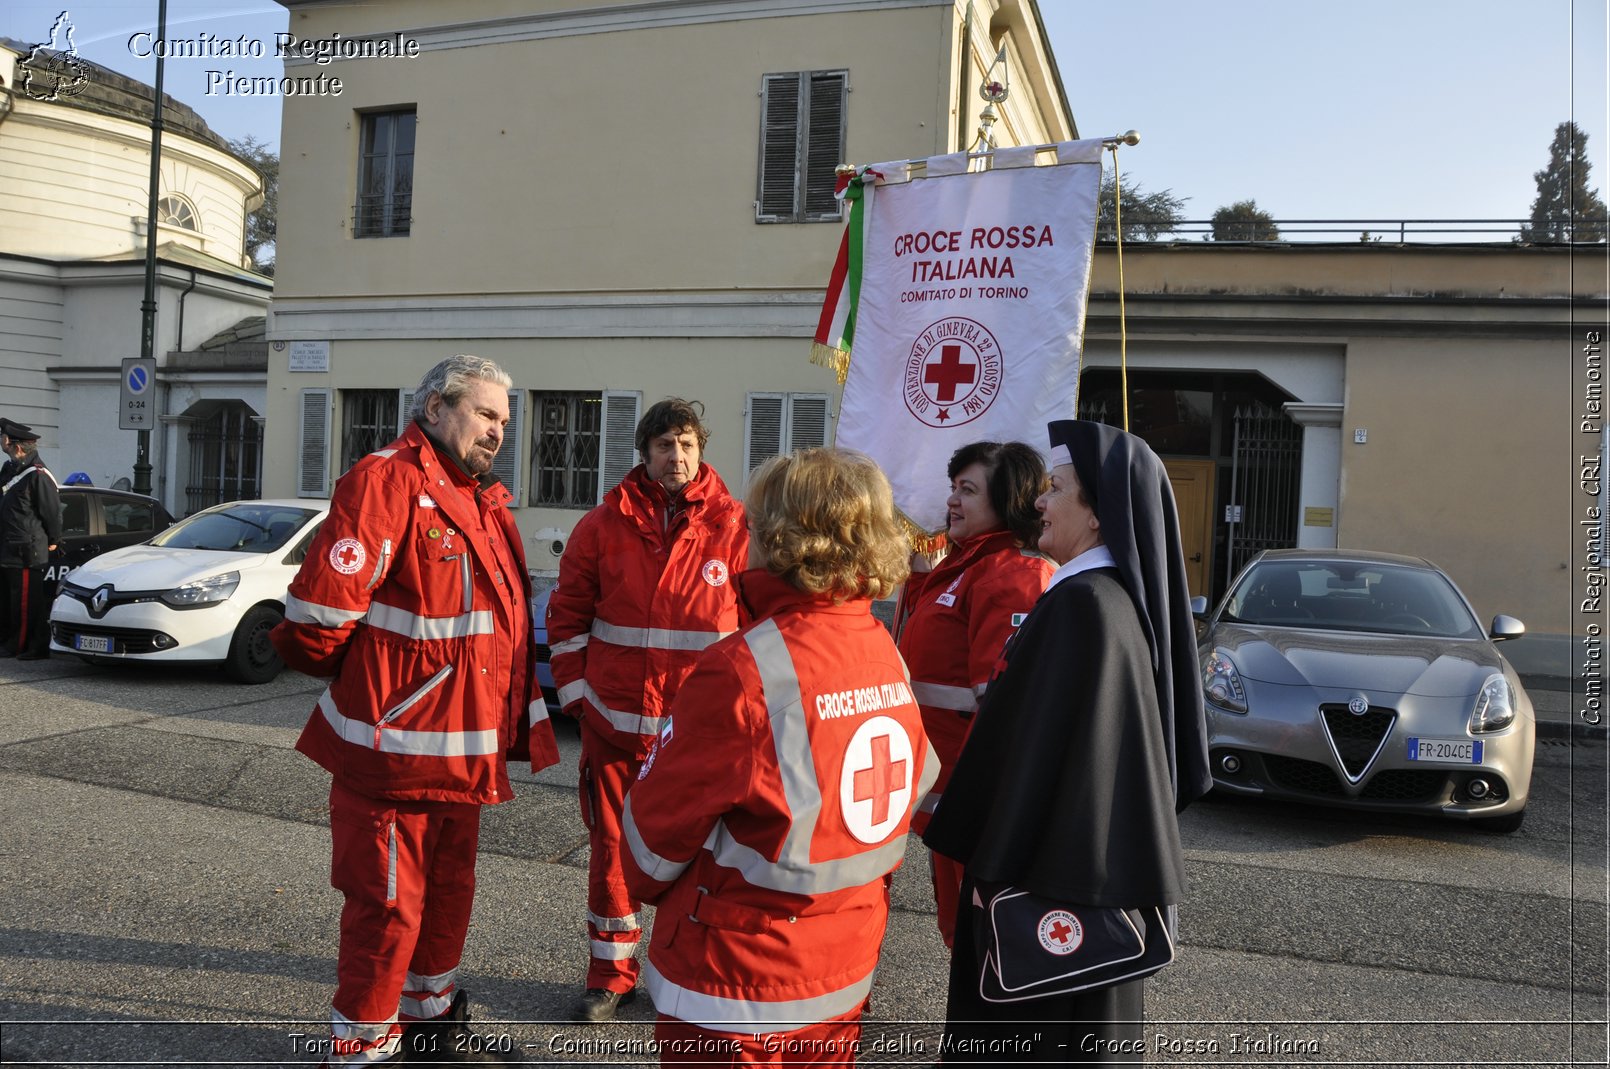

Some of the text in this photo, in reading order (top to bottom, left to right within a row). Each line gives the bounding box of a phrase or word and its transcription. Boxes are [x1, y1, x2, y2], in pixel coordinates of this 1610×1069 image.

[894, 225, 1053, 257] CROCE ROSSA
[912, 256, 1015, 282] ITALIANA
[901, 287, 1029, 303] COMITATO DI TORINO
[907, 321, 999, 416] CONVENZIONE DI GINEVRA 22 AGOSTO 1864
[816, 690, 855, 720] CROCE
[854, 686, 883, 714] ROSSA
